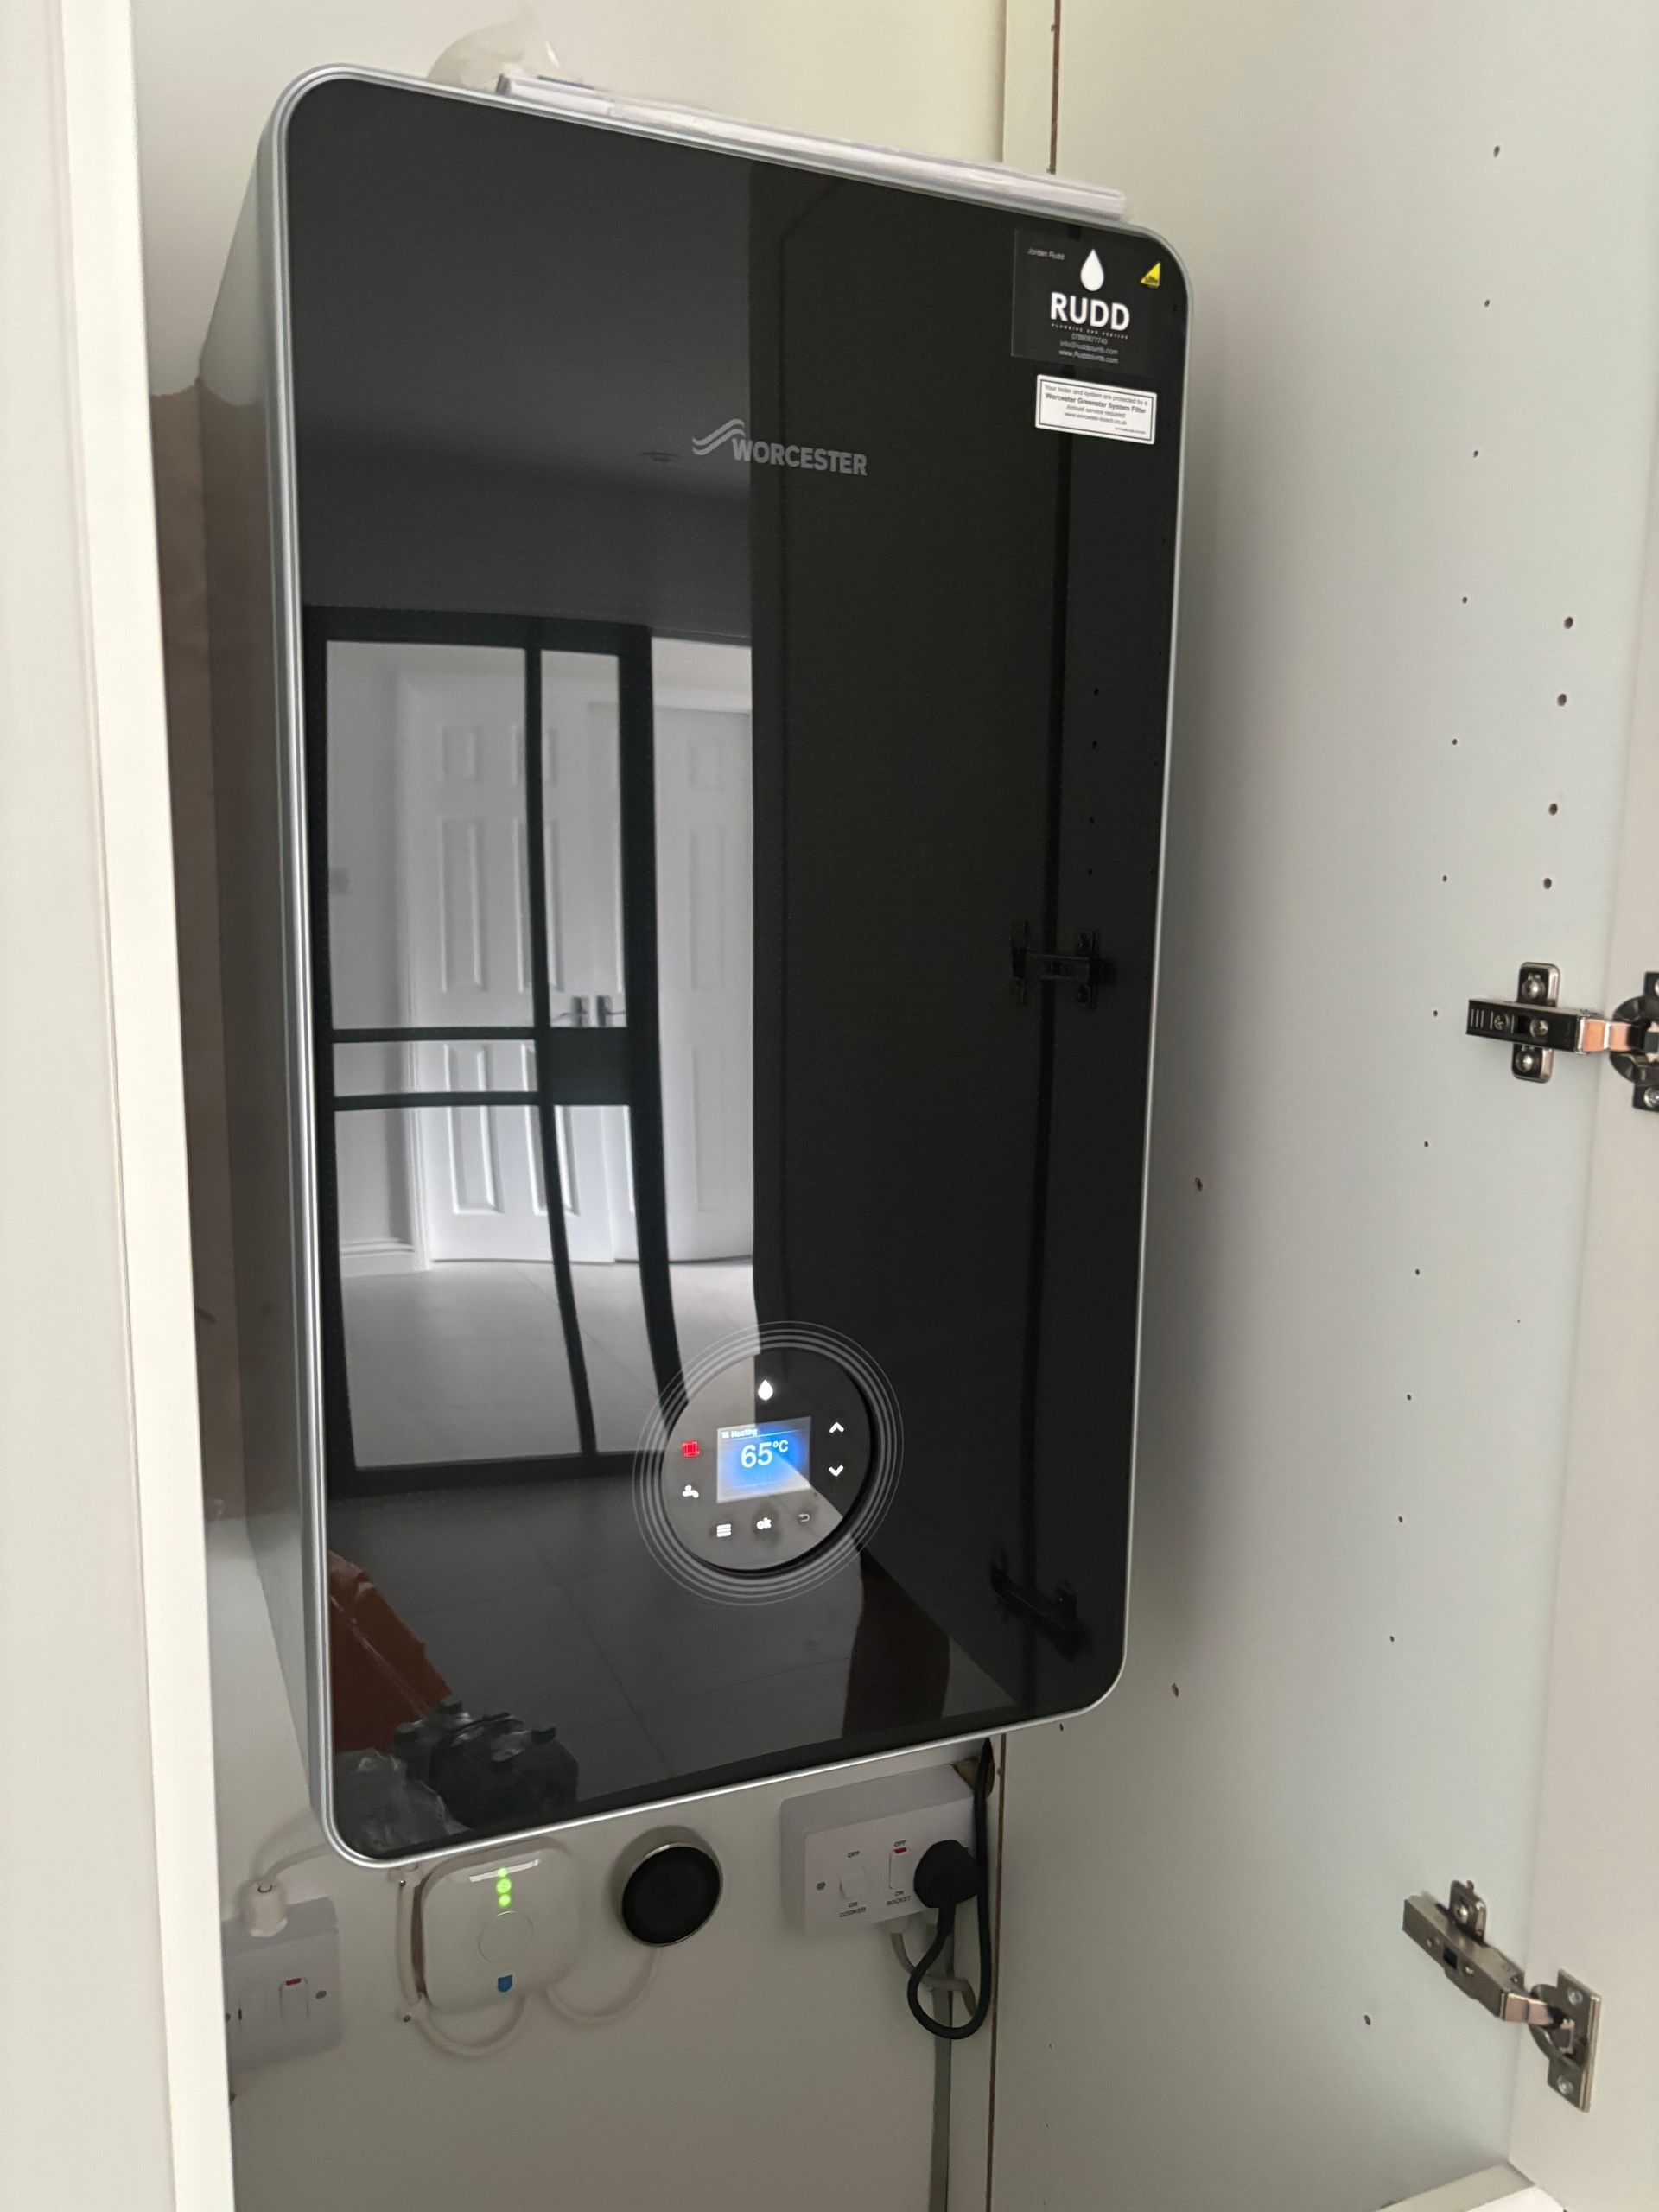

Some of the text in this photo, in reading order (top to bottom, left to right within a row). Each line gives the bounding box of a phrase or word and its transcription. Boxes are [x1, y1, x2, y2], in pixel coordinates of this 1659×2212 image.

[1051, 292, 1130, 331] RUDD
[1046, 393, 1076, 403] Worcester
[1077, 397, 1107, 407] Greenstar
[1108, 402, 1130, 411] System
[1113, 394, 1136, 404] protected
[1137, 397, 1143, 406] by
[1104, 410, 1125, 418] required
[732, 438, 868, 475] WORCESTER
[731, 1428, 758, 1438] Heating
[887, 1896, 911, 1906] SOCKET
[839, 1907, 866, 1917] COOKER
